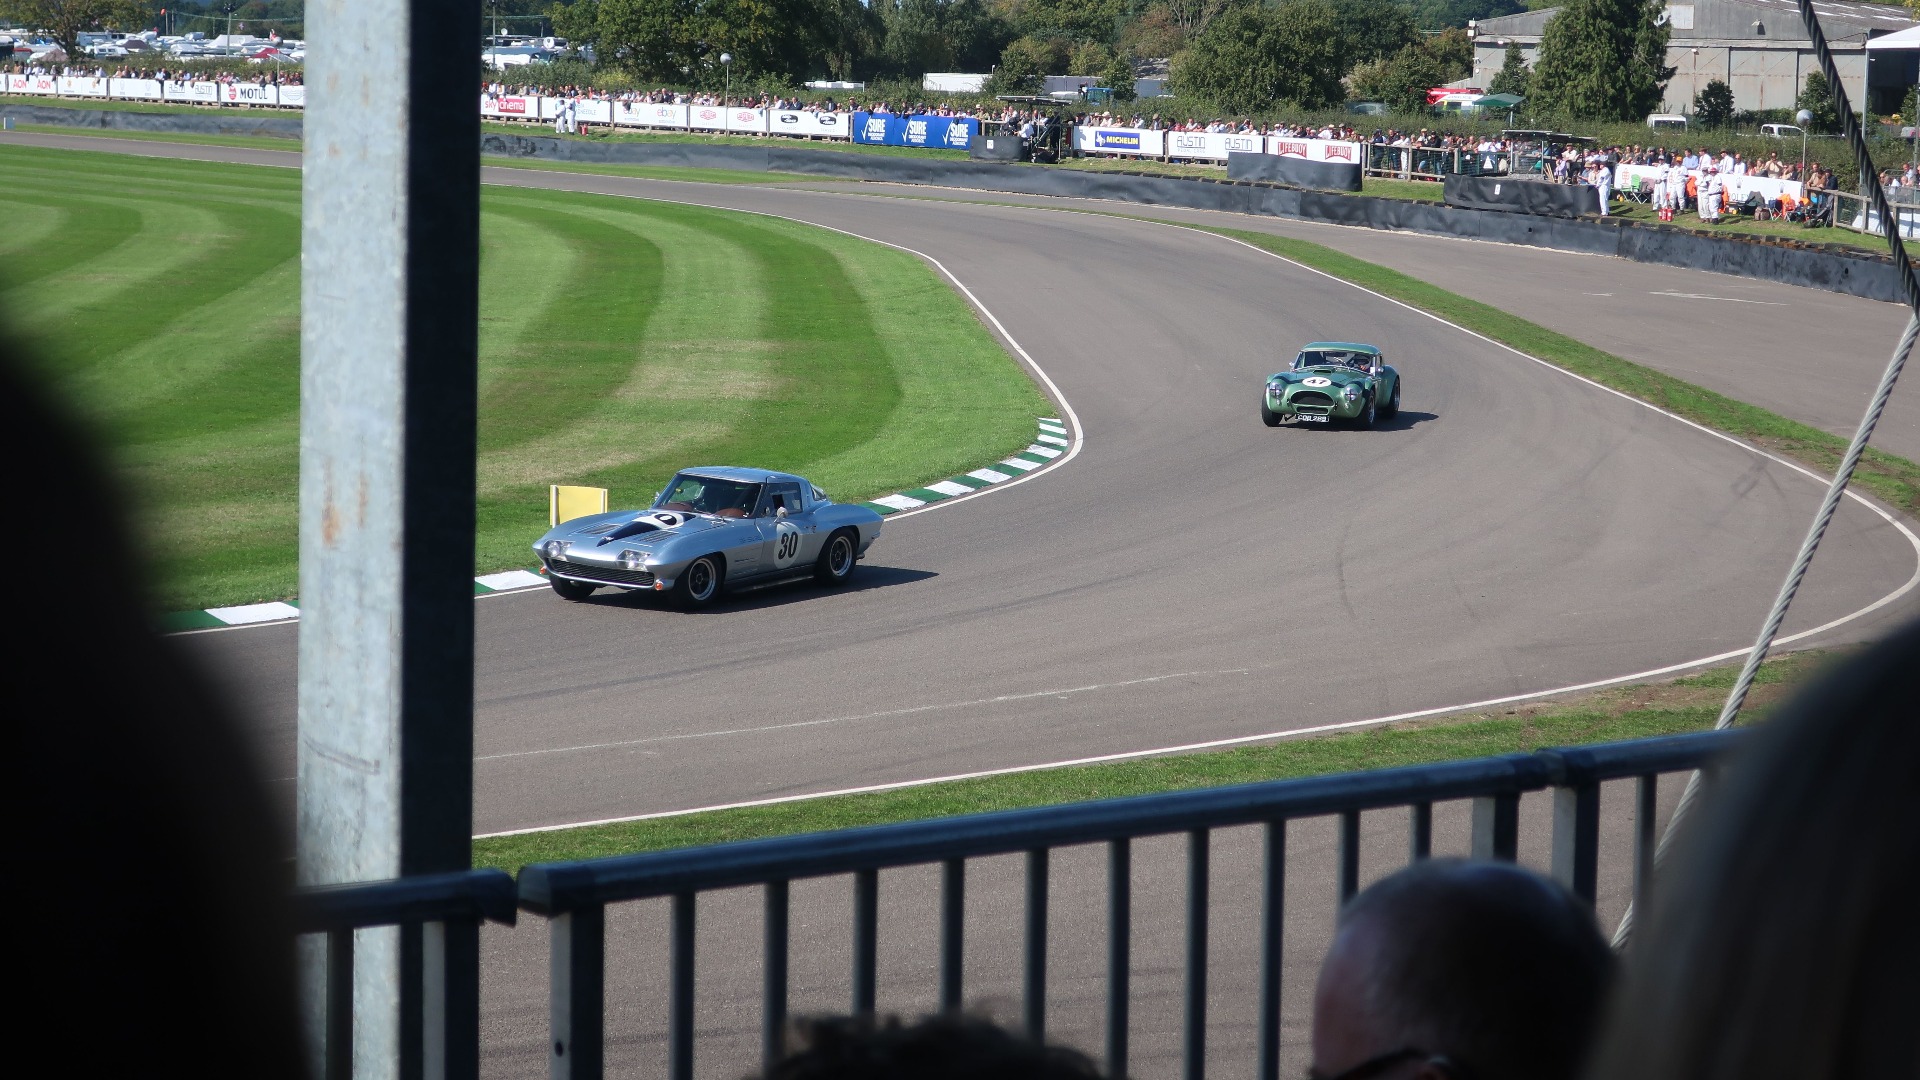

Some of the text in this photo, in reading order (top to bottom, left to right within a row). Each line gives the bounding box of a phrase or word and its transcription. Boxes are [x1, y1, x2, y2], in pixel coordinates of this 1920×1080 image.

[13, 79, 27, 89] AON
[37, 80, 51, 90] AON
[240, 88, 268, 99] MOTUL
[485, 99, 497, 110] sky
[657, 107, 677, 119] ebay
[868, 118, 886, 133] SURE
[909, 120, 927, 136] SURE
[950, 123, 969, 138] SURE
[1106, 135, 1139, 145] MICHELIN
[1177, 135, 1205, 149] AUSTIN
[1225, 137, 1253, 151] AUSTIN
[1278, 142, 1307, 158] LIFEBUOY
[1325, 145, 1352, 161] LIFEBUOY
[778, 531, 799, 560] 30
